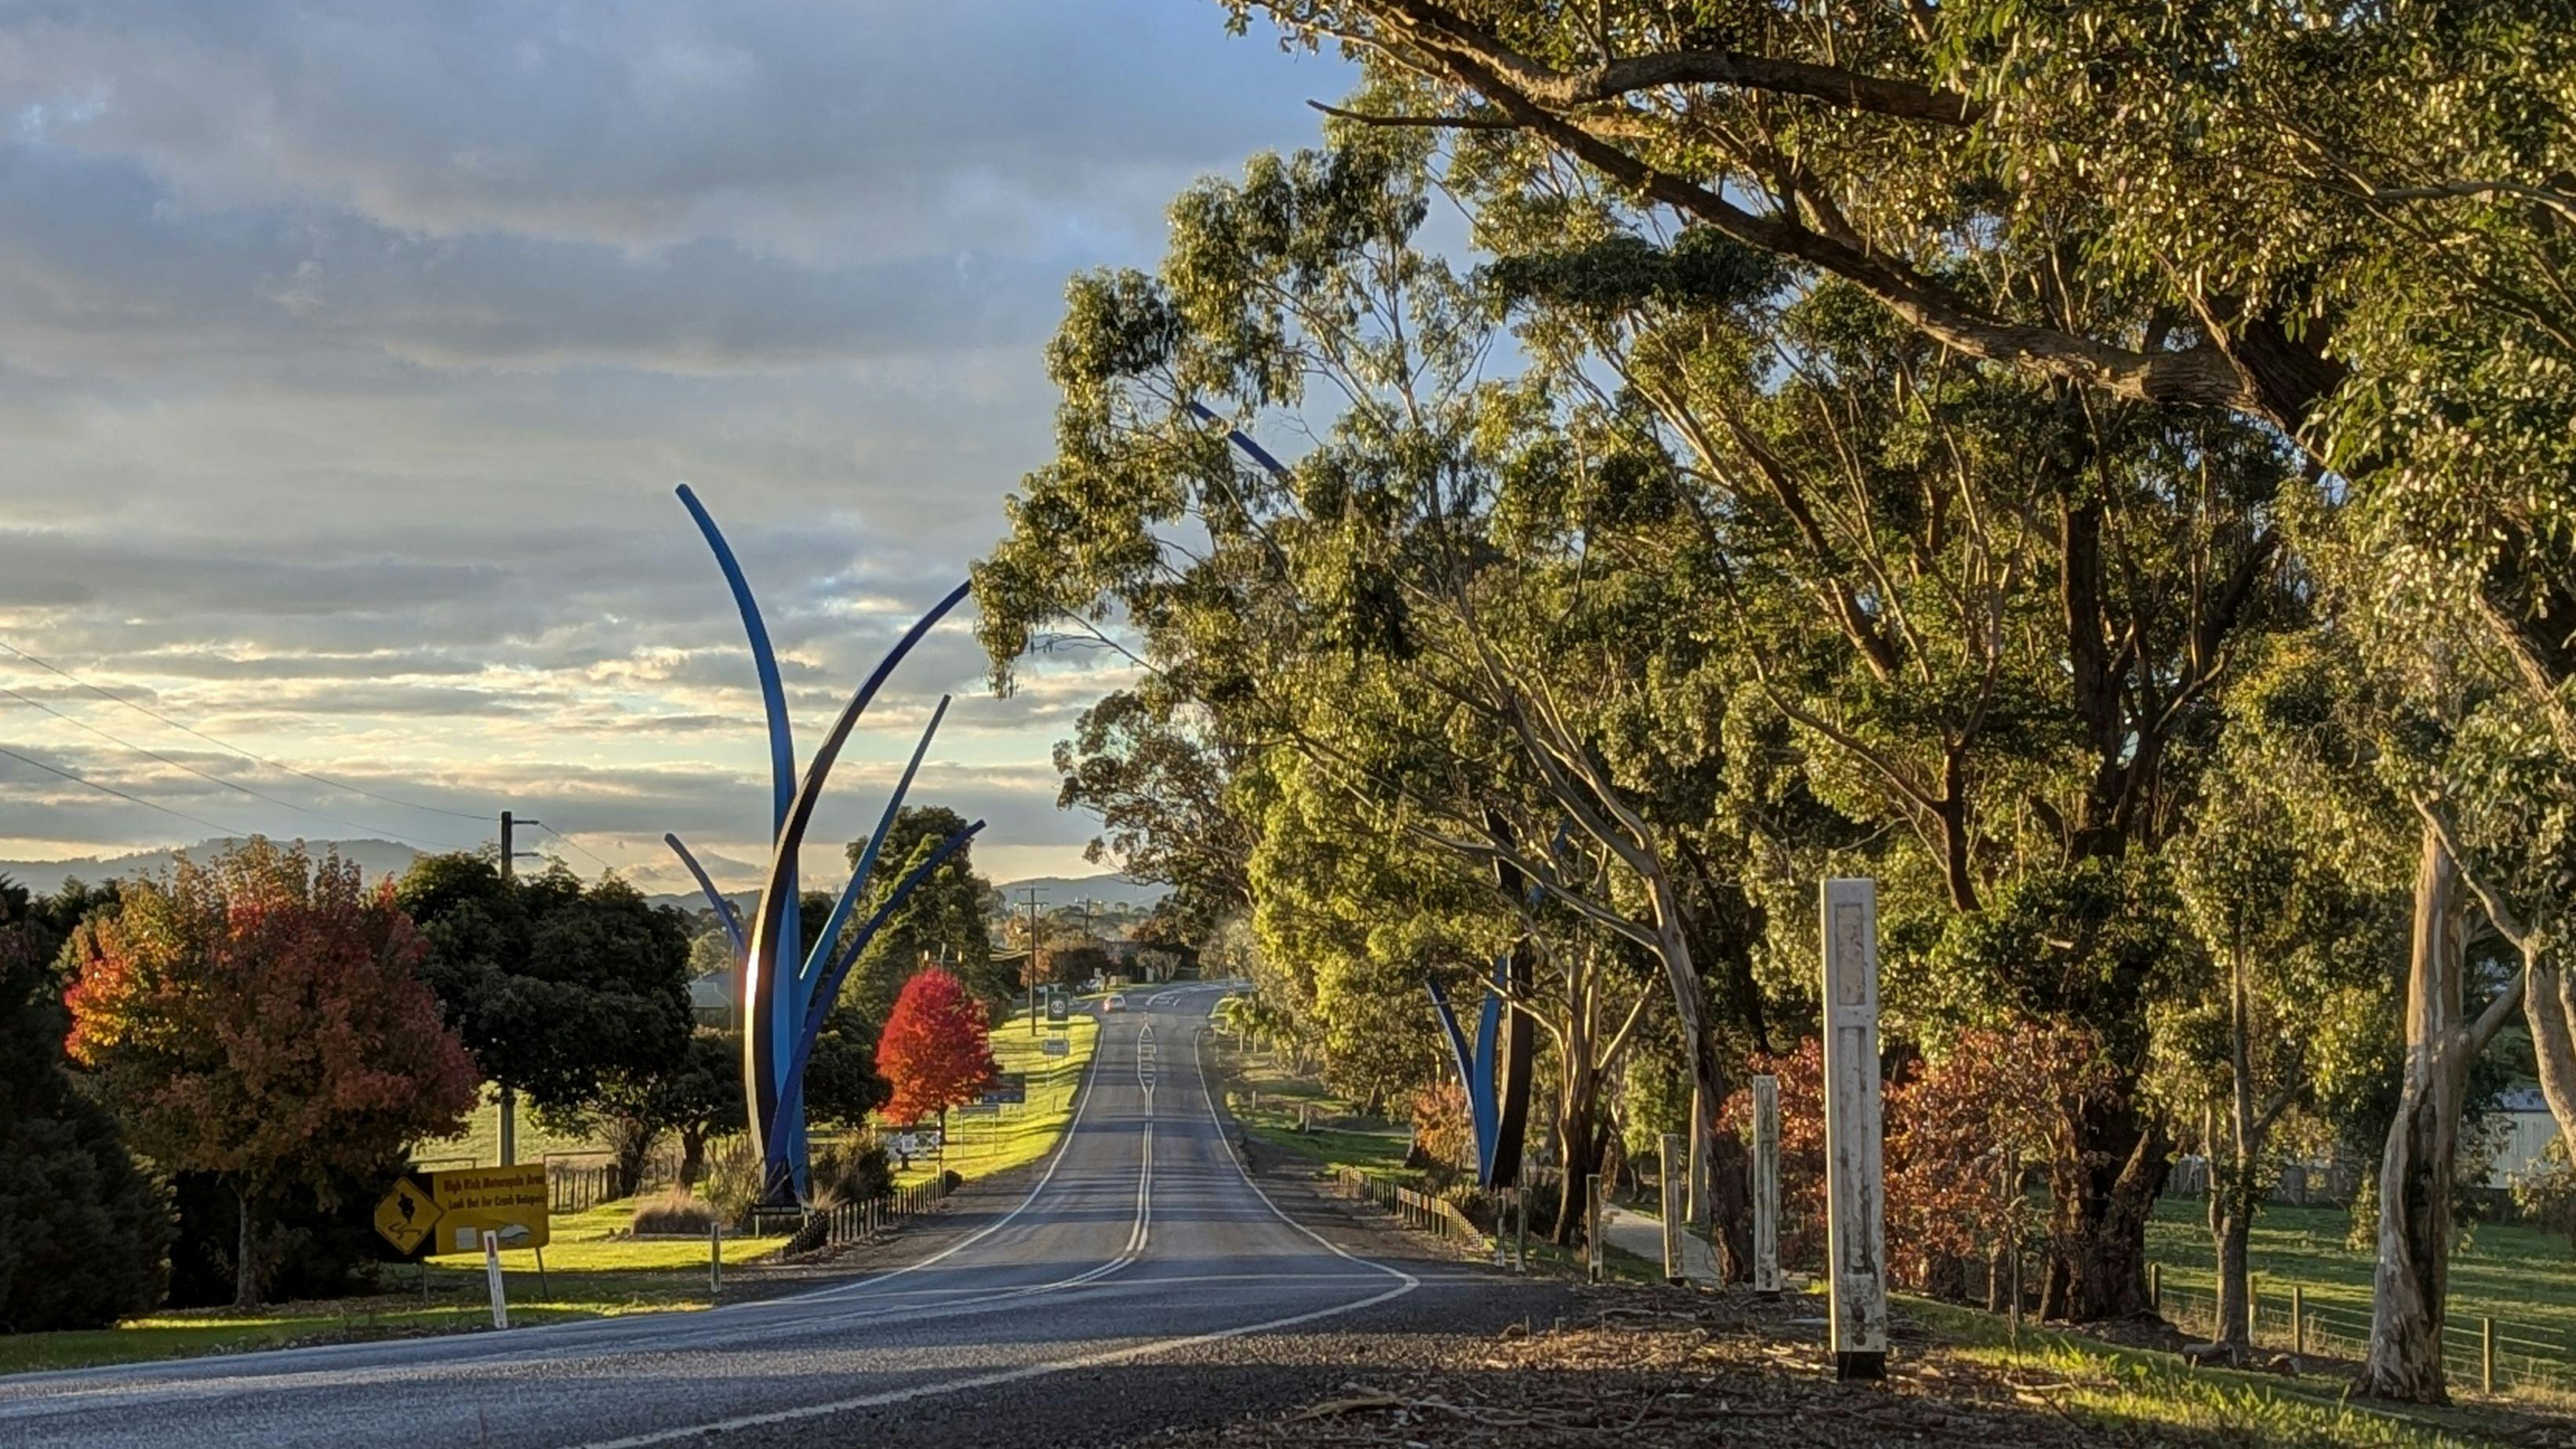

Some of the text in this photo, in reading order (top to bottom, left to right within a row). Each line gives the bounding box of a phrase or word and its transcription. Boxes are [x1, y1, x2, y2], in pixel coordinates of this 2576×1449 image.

[444, 1173, 545, 1194] High Risk Motorcycle Area
[449, 1198, 464, 1211] Look
[467, 1197, 479, 1208] Out
[495, 1194, 514, 1206] Crash
